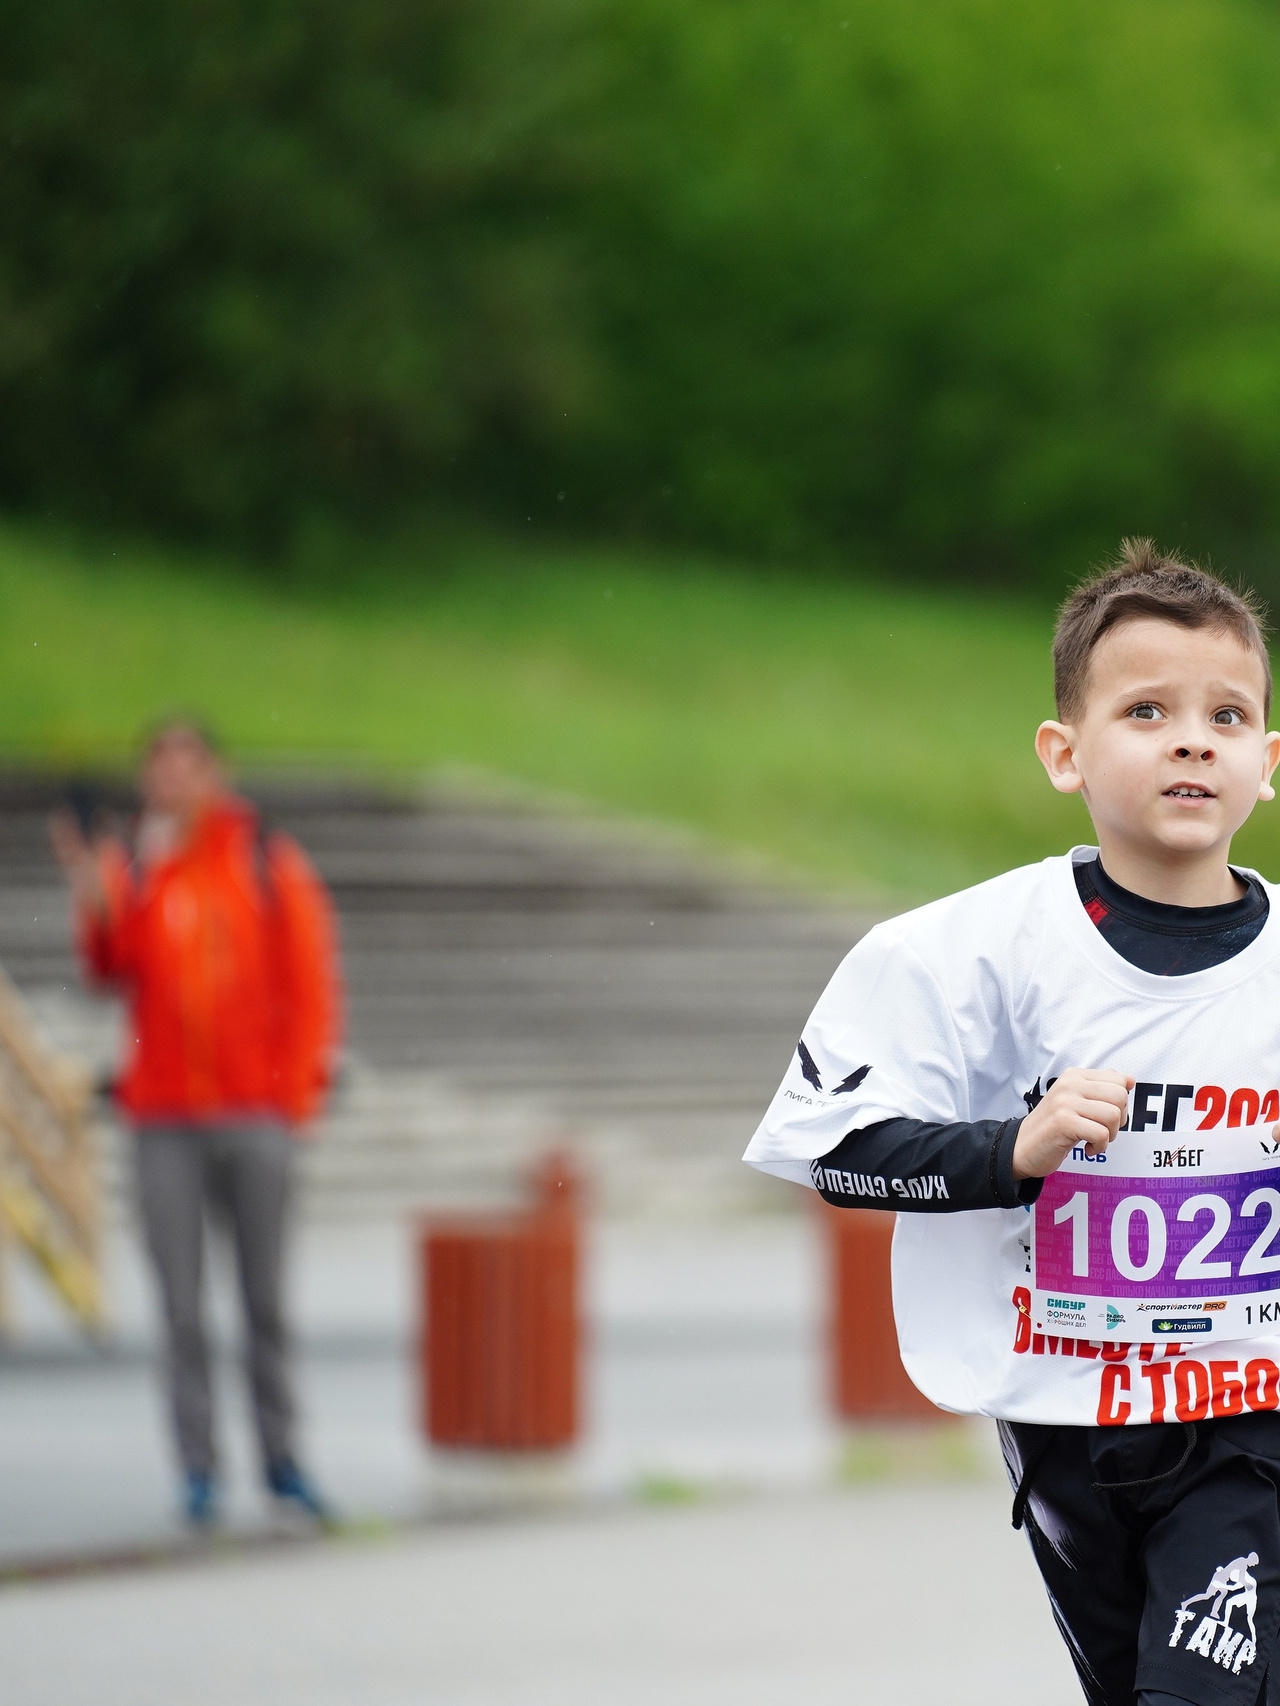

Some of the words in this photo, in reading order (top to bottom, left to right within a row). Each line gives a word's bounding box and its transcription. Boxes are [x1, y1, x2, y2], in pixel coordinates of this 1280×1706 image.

[784, 1090, 812, 1105] ЛИГА
[892, 1175, 950, 1200] КЛУБ
[1047, 1298, 1086, 1311] СИБУР
[1203, 1302, 1226, 1311] PRO
[1047, 1310, 1086, 1321] ФОРМУЛА
[1245, 1306, 1252, 1325] 1
[1047, 1318, 1074, 1327] ХОРОШИХ
[1174, 1323, 1206, 1331] Гудвилл
[1097, 1364, 1132, 1427] С
